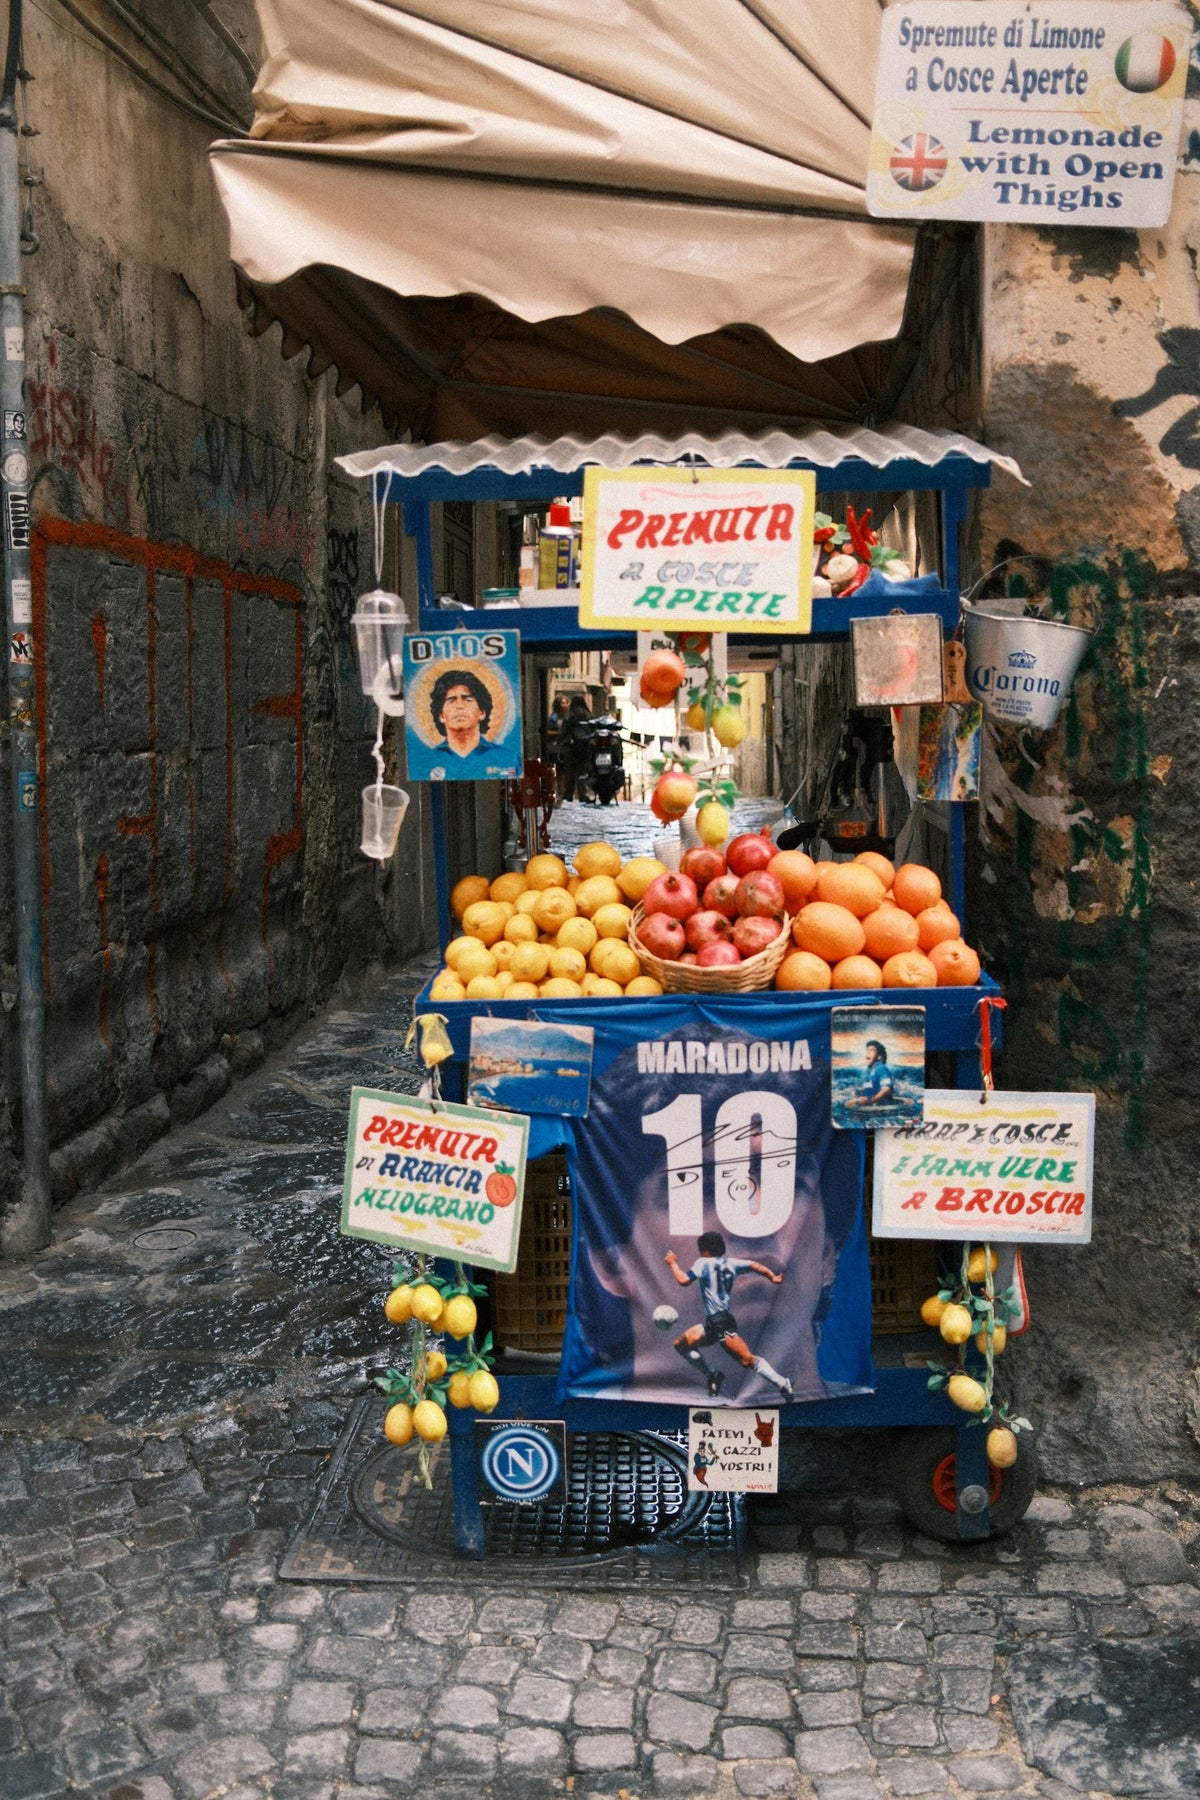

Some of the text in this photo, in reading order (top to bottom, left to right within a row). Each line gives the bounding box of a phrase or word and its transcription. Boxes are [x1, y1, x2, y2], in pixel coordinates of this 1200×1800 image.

[900, 16, 1106, 53] Spremute di Limone
[906, 57, 1088, 102] a Cosce Aperte
[968, 120, 1163, 148] Lemonade
[959, 152, 1163, 183] with Open
[993, 182, 1123, 213] Thighs
[607, 503, 794, 550] PREMUTA
[619, 560, 760, 587] A COSCE
[633, 585, 787, 618] APERTE
[409, 634, 506, 663] D10S
[974, 665, 1060, 697] Corona
[637, 1039, 812, 1074] MARADONA
[363, 1115, 498, 1163] PREMUTA
[989, 1122, 1073, 1145] COSCE
[355, 1153, 483, 1194] DI ARANCIA
[641, 1090, 798, 1238] 10
[911, 1153, 995, 1178] FAMM
[997, 1156, 1078, 1183] VERE
[901, 1187, 1086, 1216] A BRIOSCIA
[490, 1422, 509, 1431] QUI
[535, 1424, 550, 1434] UN
[702, 1429, 744, 1439] FATEVI
[506, 1448, 536, 1477] N
[723, 1446, 761, 1456] CAZZI
